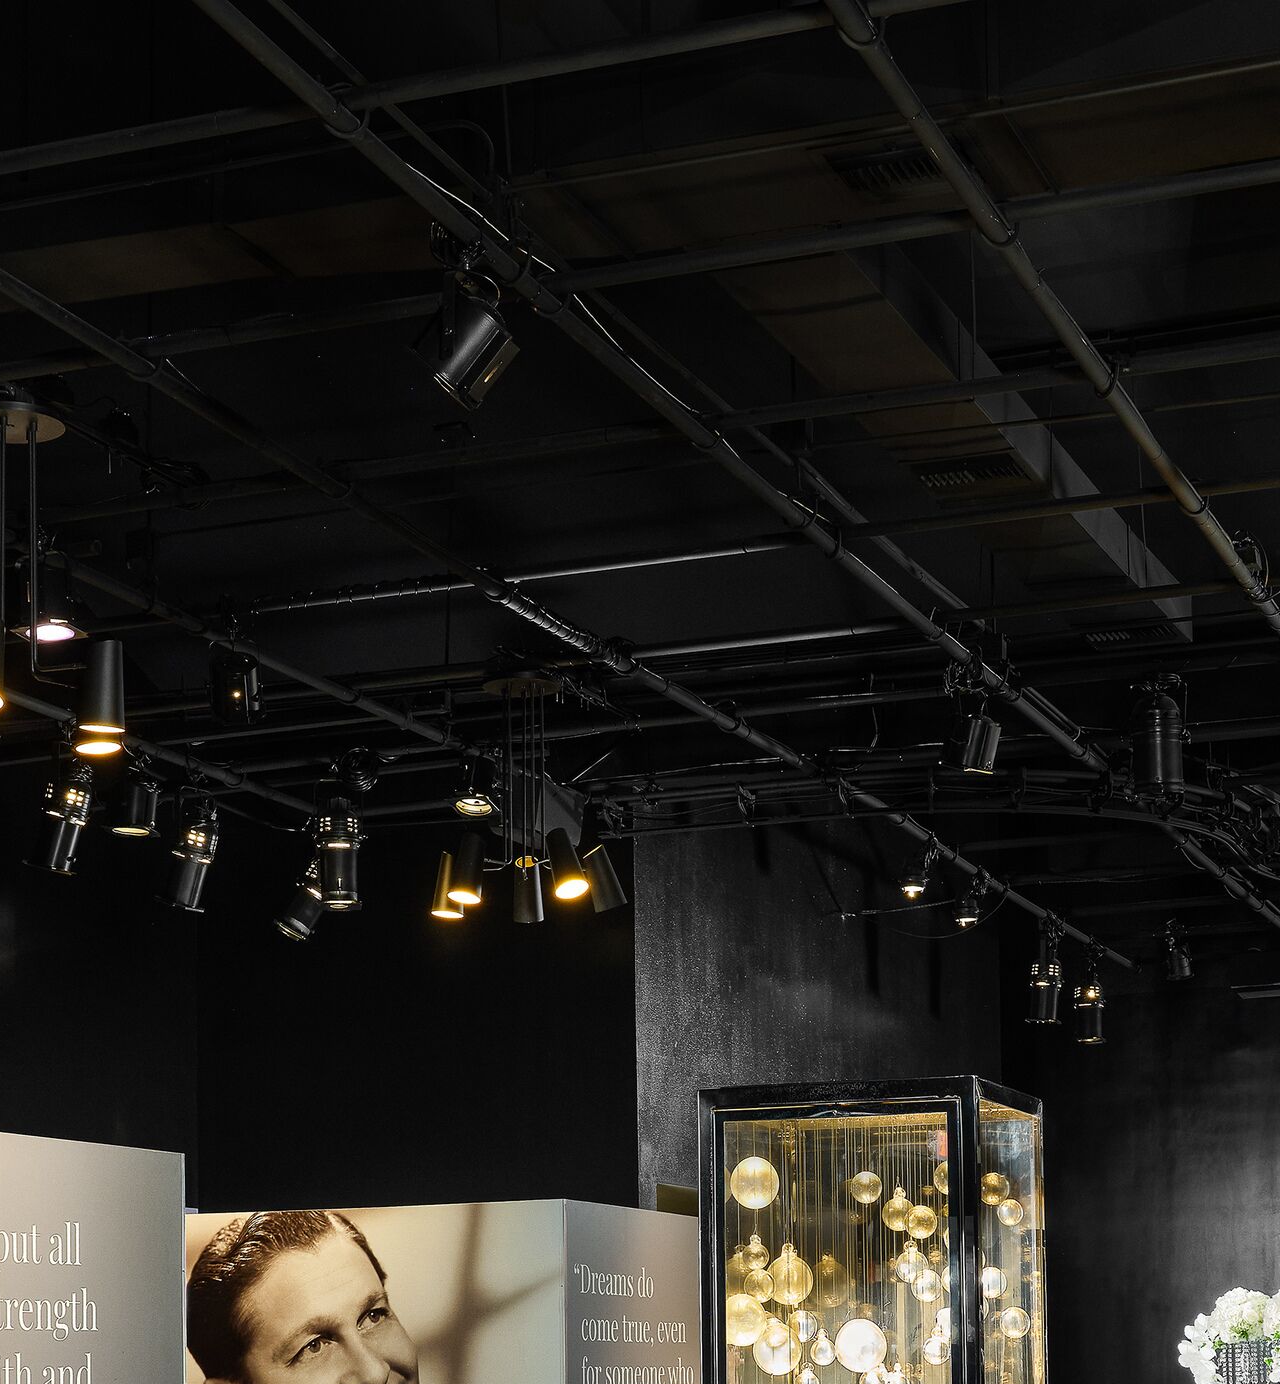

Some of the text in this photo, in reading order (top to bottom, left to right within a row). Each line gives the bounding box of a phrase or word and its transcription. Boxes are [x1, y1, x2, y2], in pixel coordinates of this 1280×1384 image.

[49, 1221, 82, 1266] all
[573, 1264, 654, 1299] “Dreams do
[581, 1314, 687, 1347] come true, even
